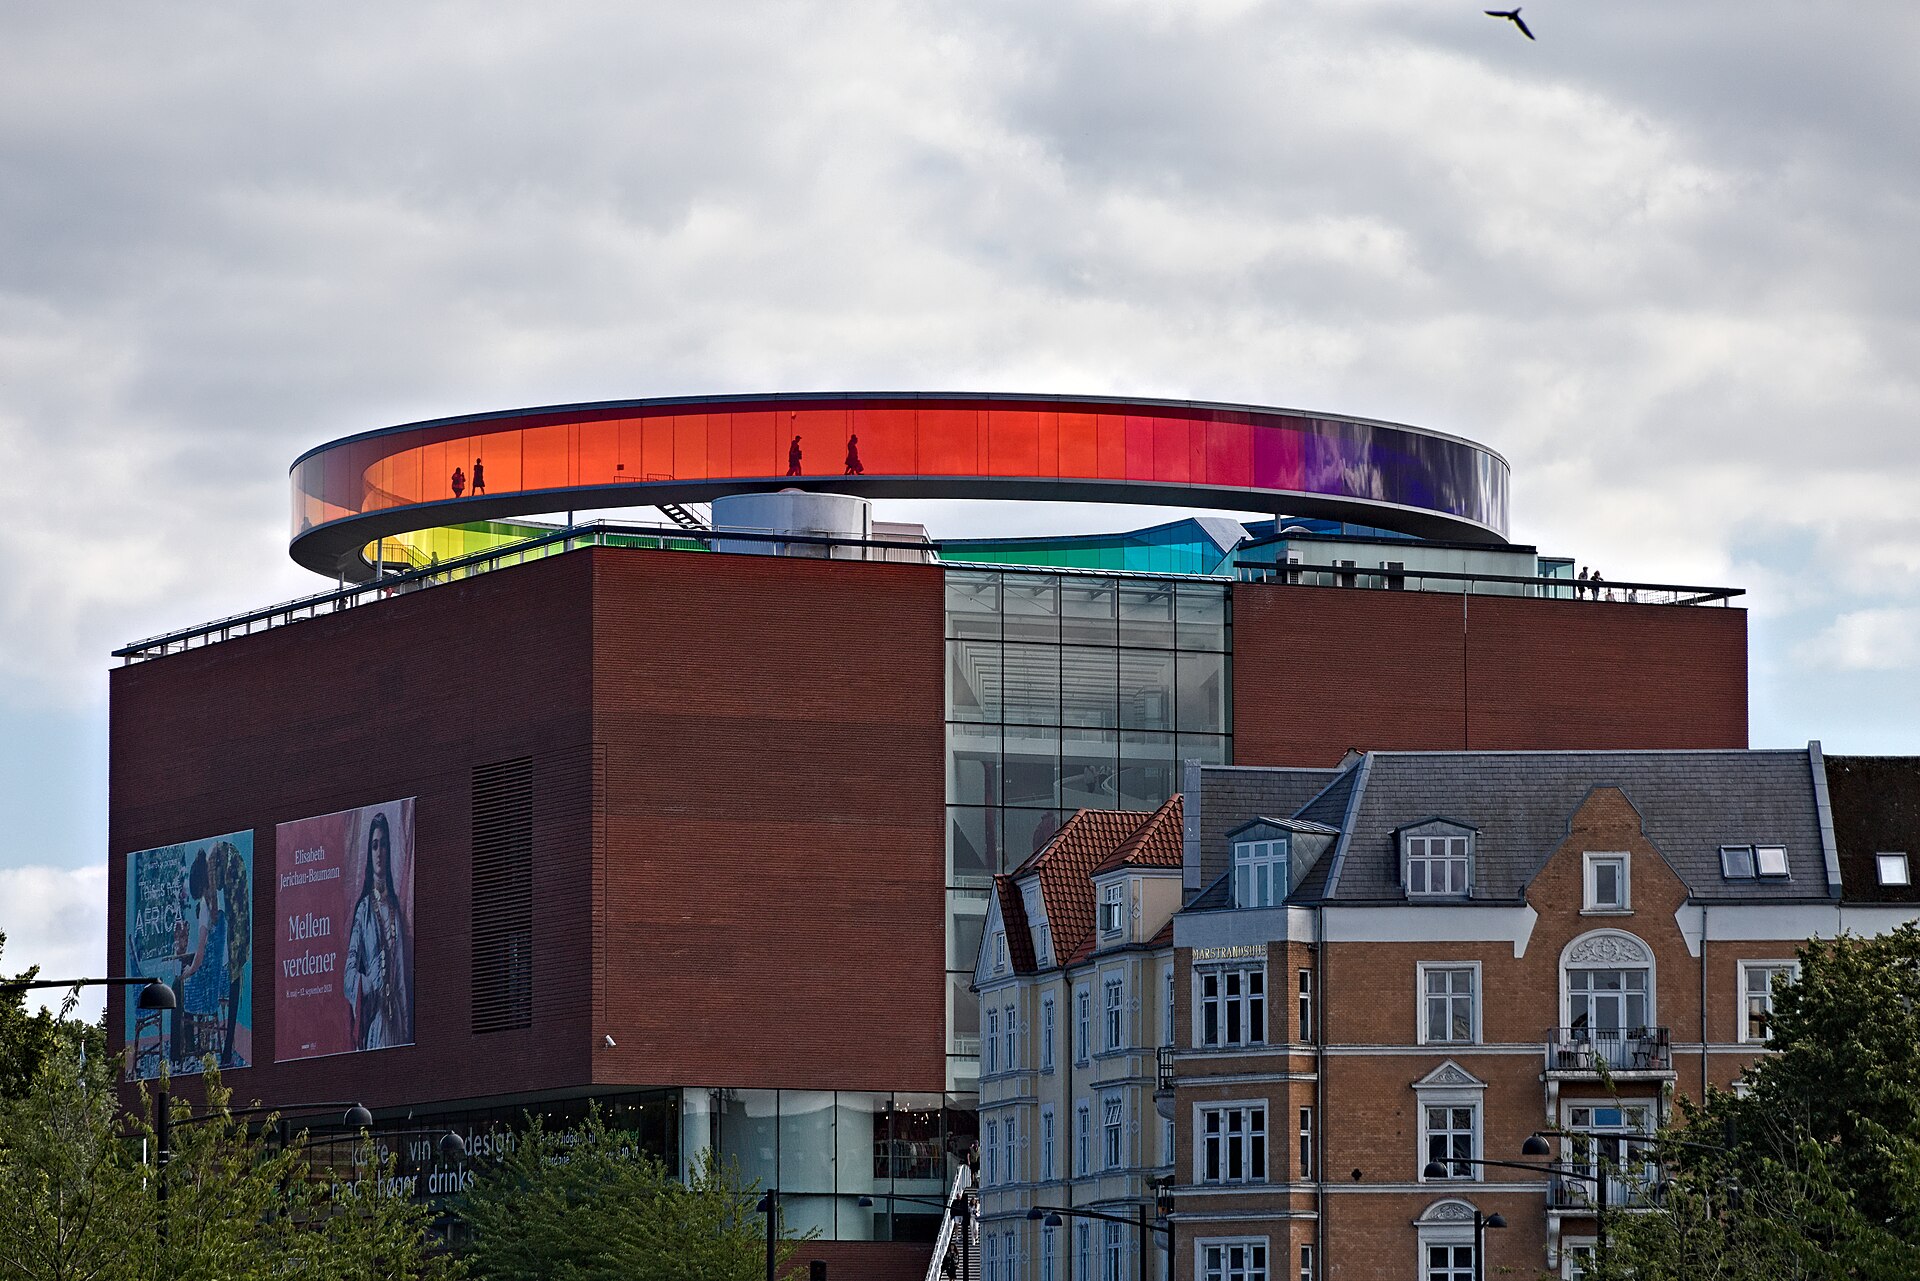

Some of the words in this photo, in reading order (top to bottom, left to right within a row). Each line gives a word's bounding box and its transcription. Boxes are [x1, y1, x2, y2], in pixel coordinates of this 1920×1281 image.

[295, 845, 325, 865] Elisabeth
[134, 904, 184, 938] AFRICA
[288, 912, 331, 942] Mellem
[283, 949, 337, 978] verdener
[410, 1134, 431, 1161] vin
[464, 1126, 516, 1163] design
[428, 1162, 475, 1194] drinks
